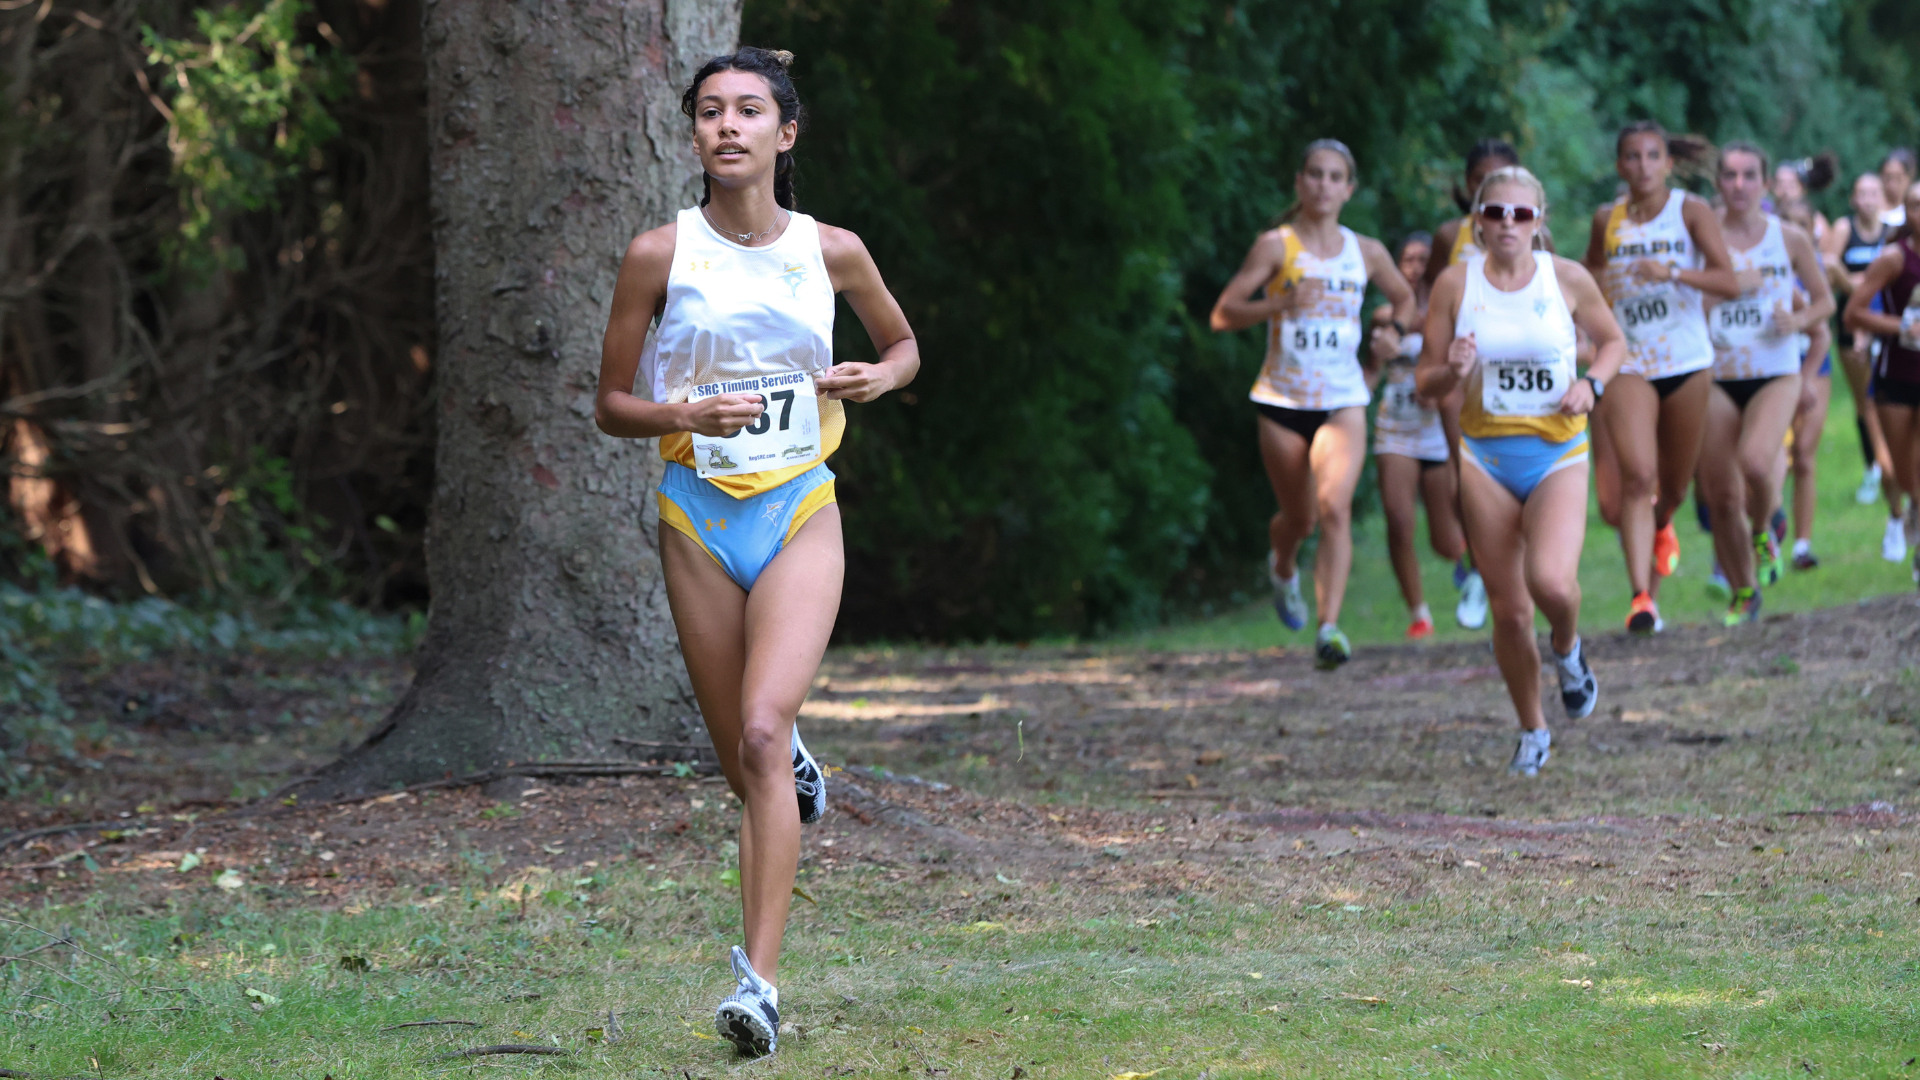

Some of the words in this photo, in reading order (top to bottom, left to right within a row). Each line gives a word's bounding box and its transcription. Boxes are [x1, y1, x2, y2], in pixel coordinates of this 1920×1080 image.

[1624, 299, 1669, 326] 500
[1720, 308, 1762, 328] 505
[1294, 329, 1339, 348] 514
[697, 383, 720, 397] SRC
[720, 379, 760, 394] Timing
[760, 372, 805, 389] Services
[1498, 367, 1554, 392] 536
[720, 389, 795, 439] 37
